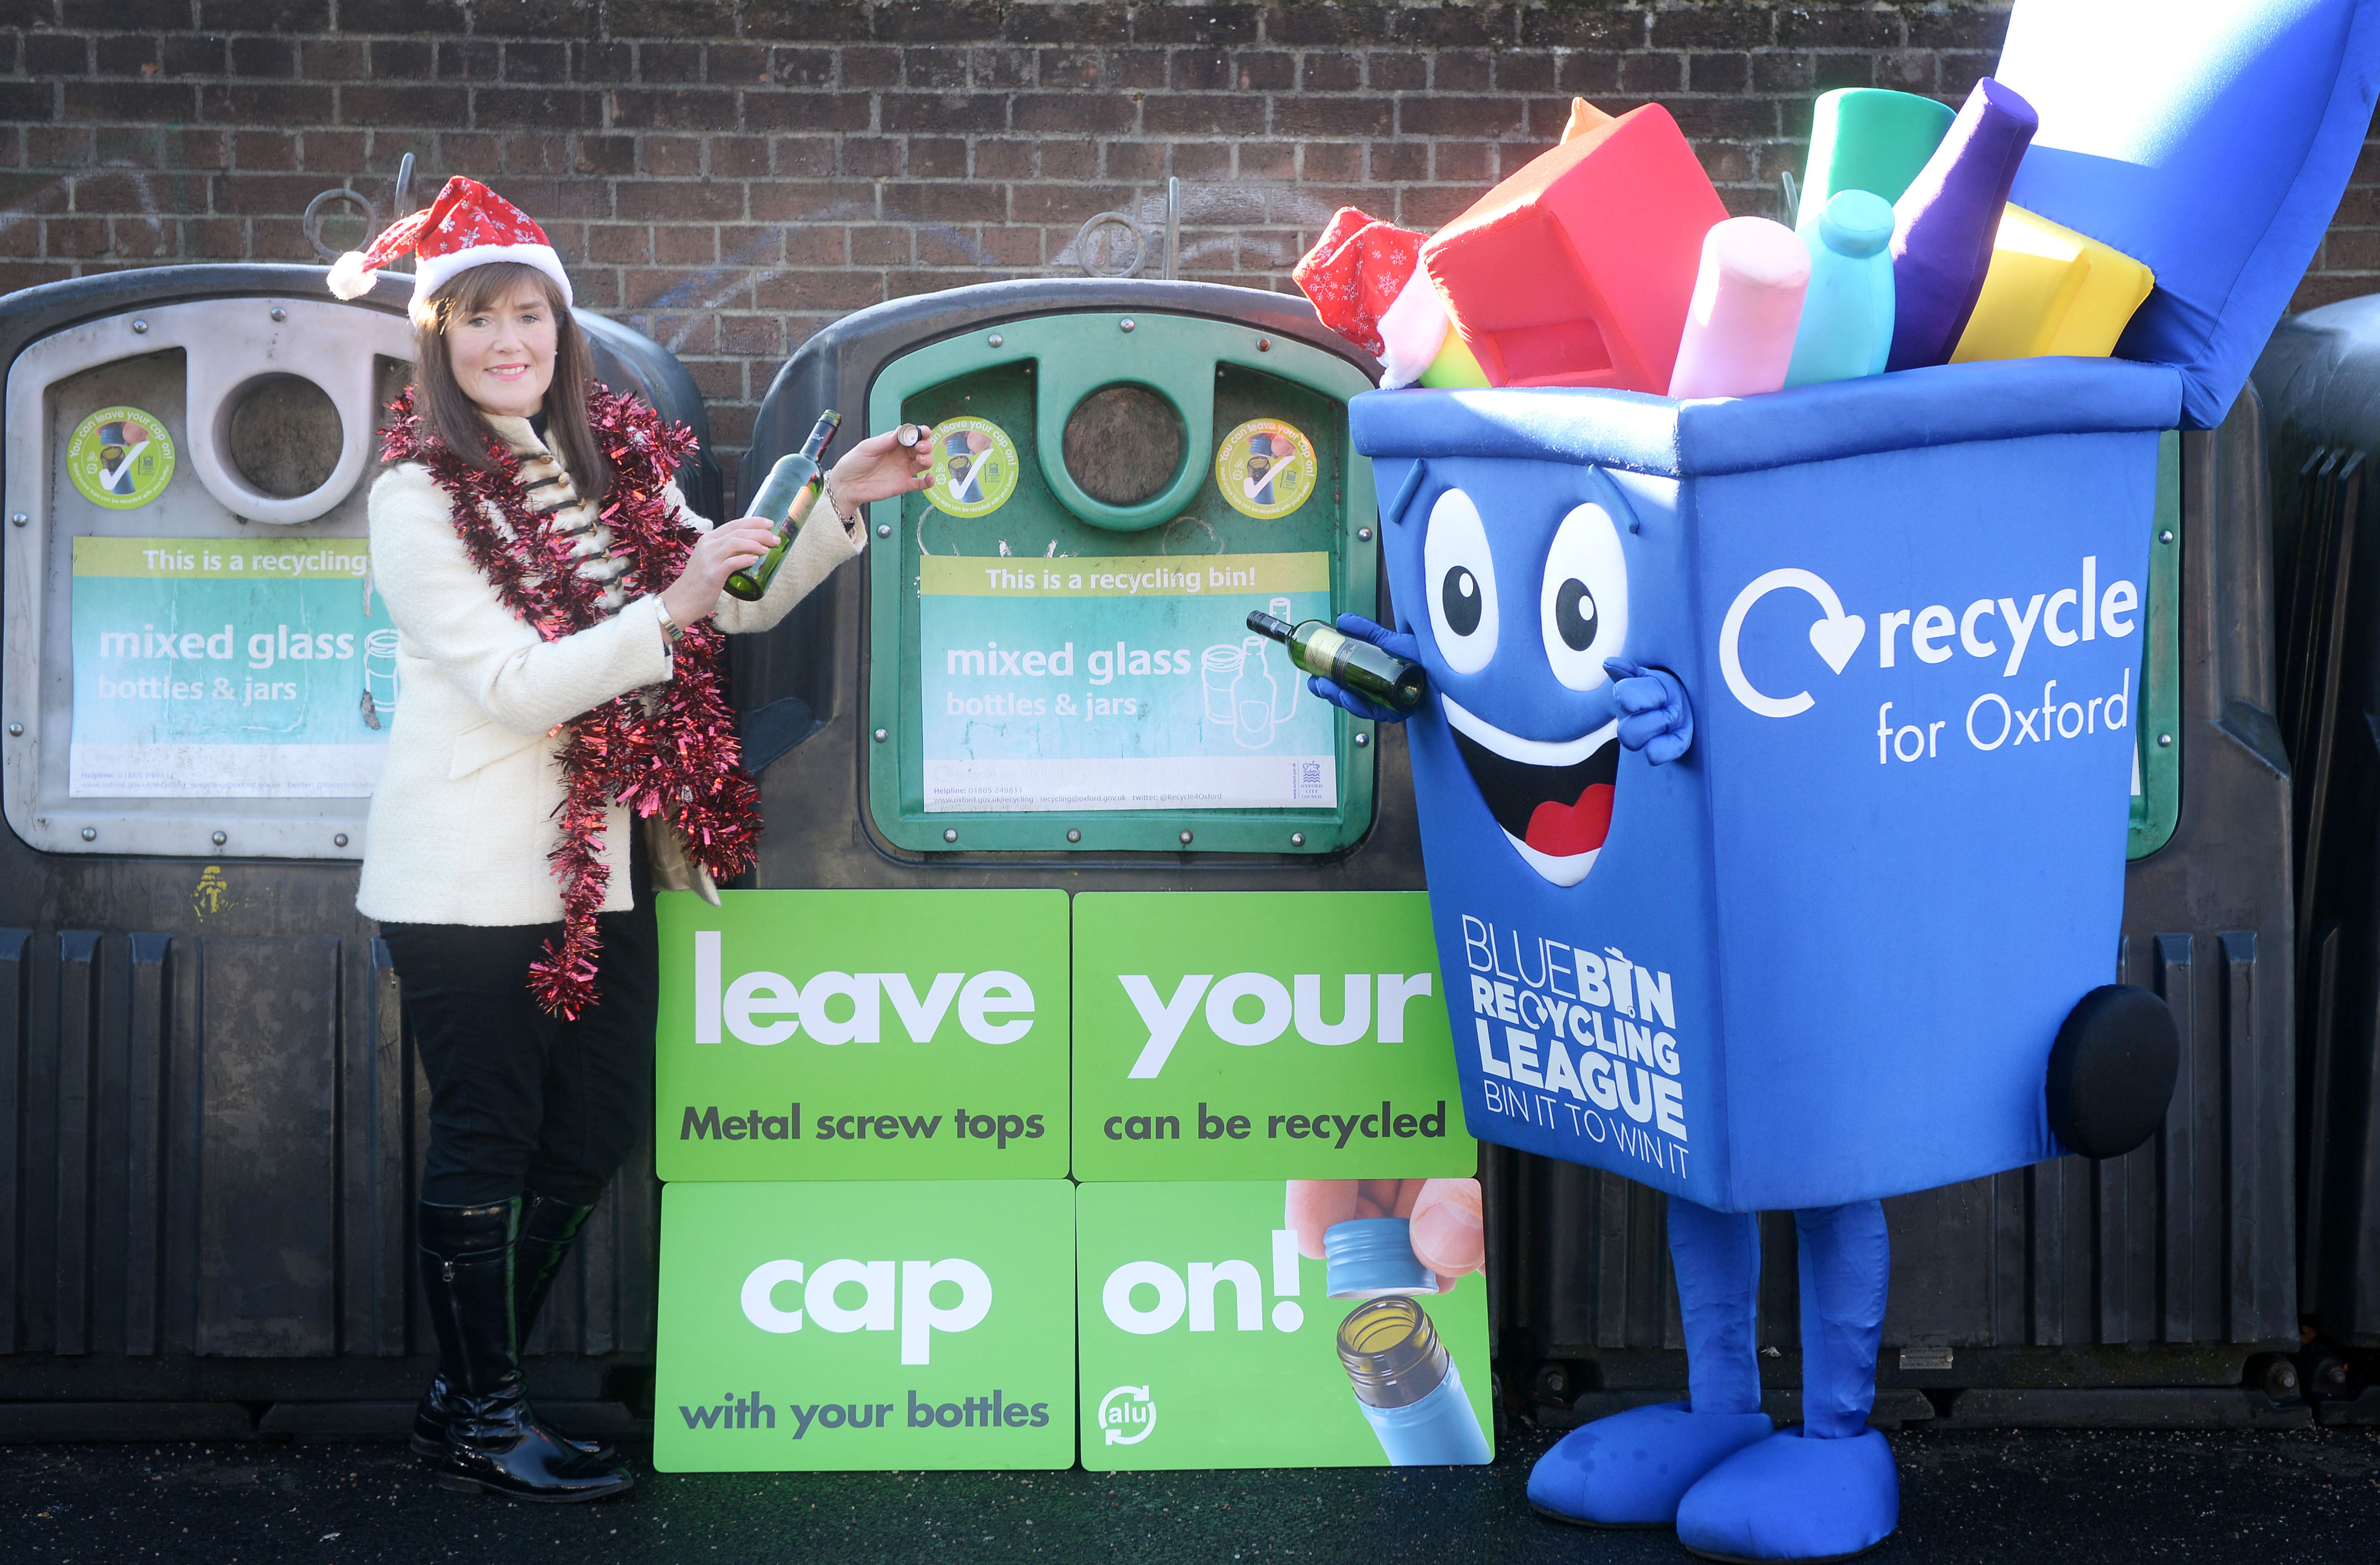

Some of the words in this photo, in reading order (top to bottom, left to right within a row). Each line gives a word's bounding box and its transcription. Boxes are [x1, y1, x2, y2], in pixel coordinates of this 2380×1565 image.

[70, 439, 82, 457] You
[79, 421, 95, 438] can
[94, 411, 124, 424] leave
[127, 411, 151, 424] your
[150, 423, 166, 441] cap
[162, 443, 173, 460] on!
[930, 432, 941, 445] an
[939, 420, 967, 434] leave
[970, 420, 993, 433] your
[993, 430, 1008, 448] cap
[1005, 449, 1017, 466] on!
[1219, 444, 1233, 462] You
[1231, 428, 1247, 443] can
[1247, 422, 1276, 433] leave
[1278, 424, 1299, 440] your
[1297, 439, 1311, 458] cap
[1306, 460, 1314, 477] on!
[120, 495, 142, 505] recycled
[970, 503, 991, 513] recycled
[142, 549, 195, 571] This
[204, 550, 221, 571] is
[230, 555, 244, 571] a
[252, 549, 368, 576] recycling
[985, 569, 1035, 590] This
[1043, 569, 1061, 590] is
[1069, 573, 1083, 589] a
[1090, 568, 1202, 594] recycling
[1208, 566, 1256, 588] bin!
[1880, 555, 2139, 678] recycle
[101, 624, 234, 660] mixed
[248, 624, 355, 669] glass
[947, 641, 1074, 677] mixed
[1087, 641, 1192, 686] glass
[99, 674, 203, 699] bottles
[212, 677, 235, 700] &
[242, 676, 298, 707] jars
[947, 691, 1046, 717] bottles
[1054, 693, 1078, 716] &
[1085, 691, 1137, 721] jars
[1877, 701, 1946, 765] for
[1966, 667, 2130, 751] Oxford
[81, 781, 186, 789] www.oxford.gov.uk/recycling
[934, 795, 1034, 804] www.oxford.gov.uk/recycling
[1040, 795, 1126, 804] recycling@oxford.gov.uk
[1160, 793, 1222, 801] @Recycle4Oxford
[695, 931, 1035, 1046] leave
[1117, 972, 1432, 1079] your
[1471, 974, 1680, 1075] RECYCLING
[1475, 1017, 1688, 1142] LEAGUE
[680, 1102, 800, 1141] Metal
[816, 1114, 942, 1140] screw
[954, 1109, 1045, 1149] tops
[1104, 1115, 1180, 1140] can
[1198, 1102, 1251, 1140] be
[1268, 1101, 1446, 1149] recycled
[1484, 1080, 1529, 1122] BIN
[1535, 1094, 1557, 1129] IT
[1564, 1102, 1606, 1143] TO
[1610, 1117, 1663, 1169] WIN
[1669, 1141, 1689, 1179] IT
[1102, 1229, 1304, 1335] on!
[741, 1258, 992, 1365] cap
[679, 1391, 776, 1429] with
[789, 1402, 894, 1440] your
[908, 1389, 1049, 1428] bottles
[1107, 1401, 1147, 1423] alu
